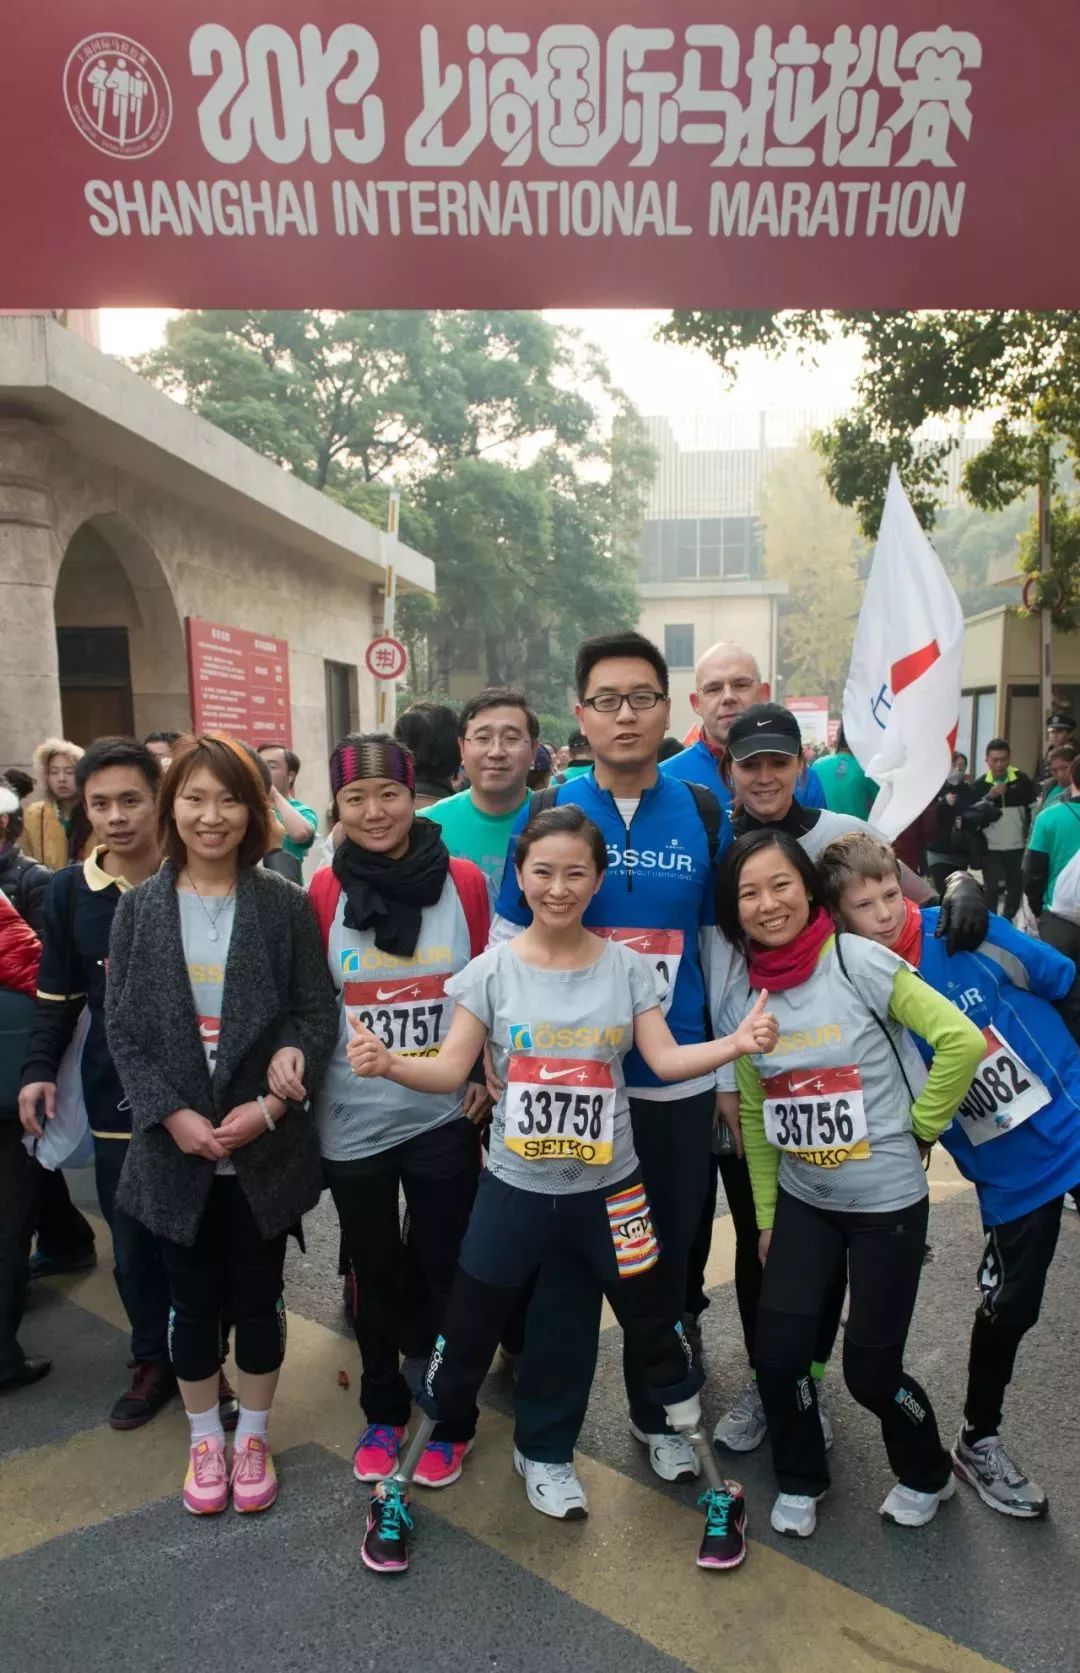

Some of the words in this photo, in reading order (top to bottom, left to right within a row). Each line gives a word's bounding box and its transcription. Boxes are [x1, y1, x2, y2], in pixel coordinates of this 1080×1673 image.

[189, 23, 385, 165] 2013
[404, 23, 983, 168] 上海国际马拉松赛
[84, 179, 319, 237] SHANGHAI
[331, 179, 693, 237] INTERNATIONAL
[708, 180, 966, 237] MARATHON
[517, 1090, 604, 1140] 33758
[774, 1099, 854, 1146] 33756
[524, 1139, 596, 1162] SEIKO
[904, 1391, 926, 1422] ÖSSUR
